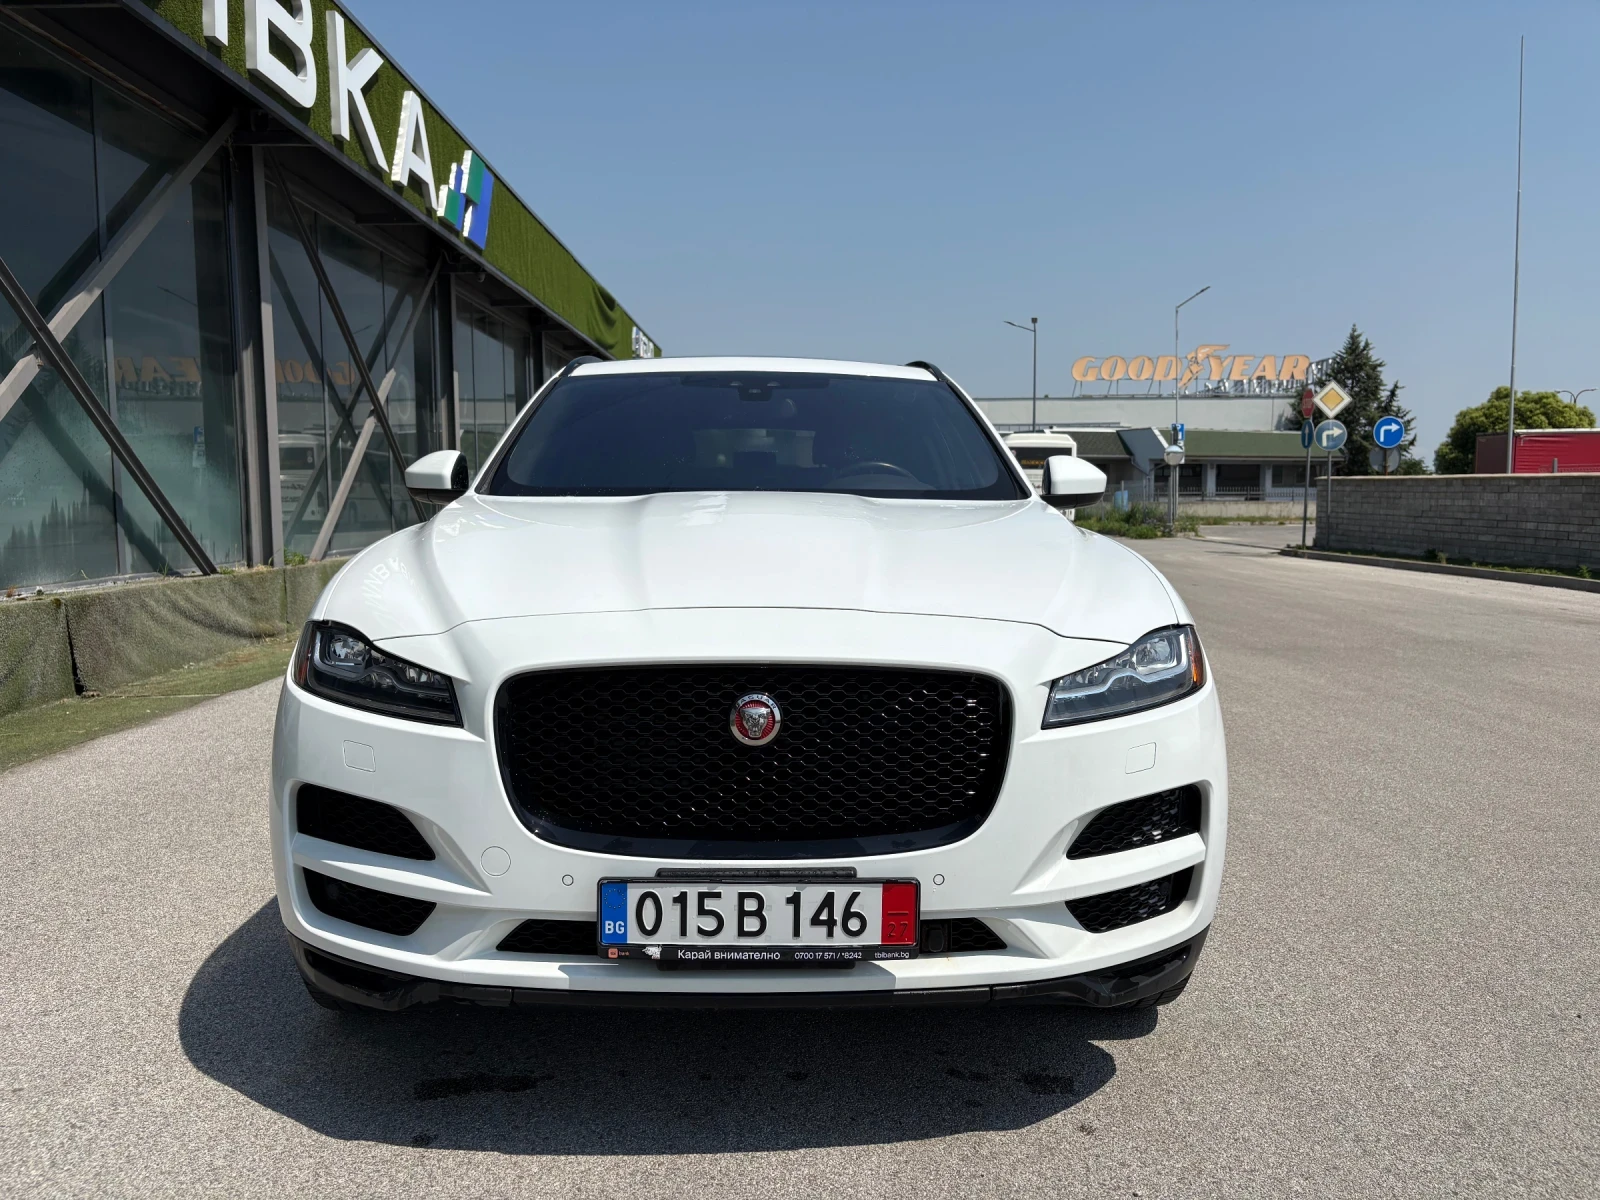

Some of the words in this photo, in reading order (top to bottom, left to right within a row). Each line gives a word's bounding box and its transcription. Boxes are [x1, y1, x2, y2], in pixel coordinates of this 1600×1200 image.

[604, 920, 625, 934] BG
[887, 921, 908, 938] 27
[677, 949, 711, 960] Карай
[714, 951, 781, 960] внимателно
[874, 951, 910, 960] tbibank.bg
